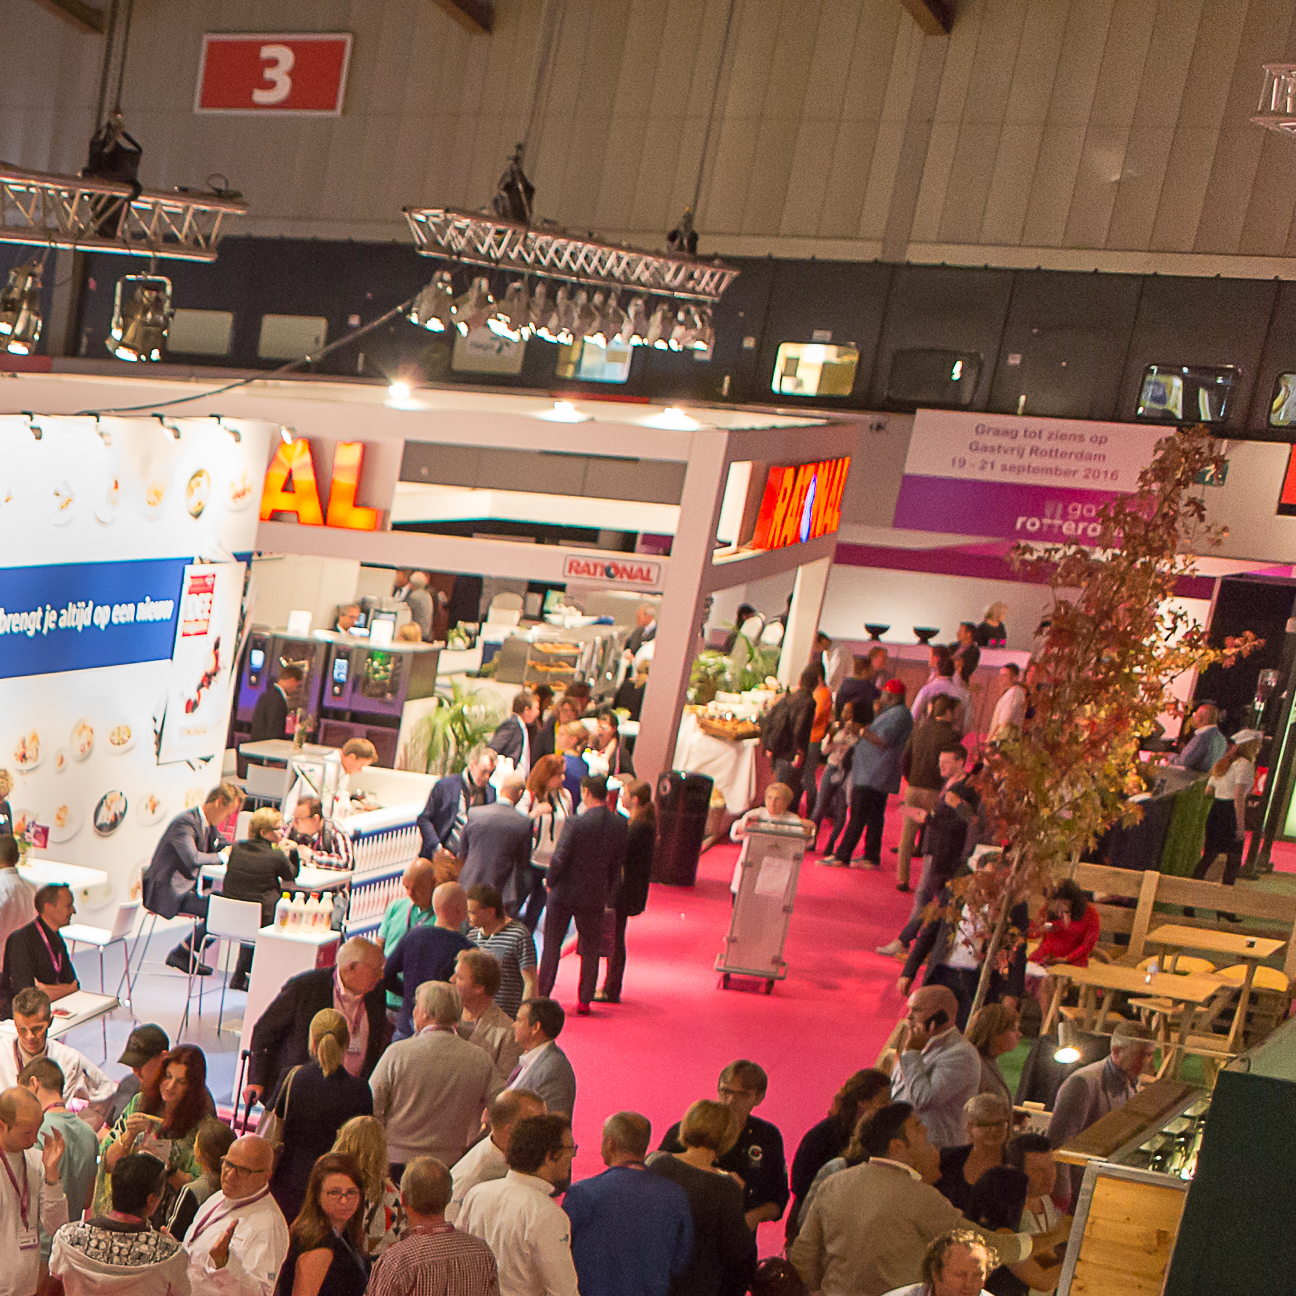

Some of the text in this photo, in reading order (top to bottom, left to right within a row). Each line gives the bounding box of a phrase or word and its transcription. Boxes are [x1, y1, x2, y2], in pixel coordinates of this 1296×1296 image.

[251, 44, 296, 106] 3
[975, 423, 1108, 446] Graag tot ziens op
[968, 441, 1106, 463] Gastvrij Rotterdam
[1000, 462, 1077, 478] september
[1082, 467, 1119, 481] 2016
[42, 604, 58, 635] je
[59, 600, 93, 632] altijd
[93, 605, 110, 630] op
[111, 602, 134, 625] een
[136, 596, 174, 623] nieuw
